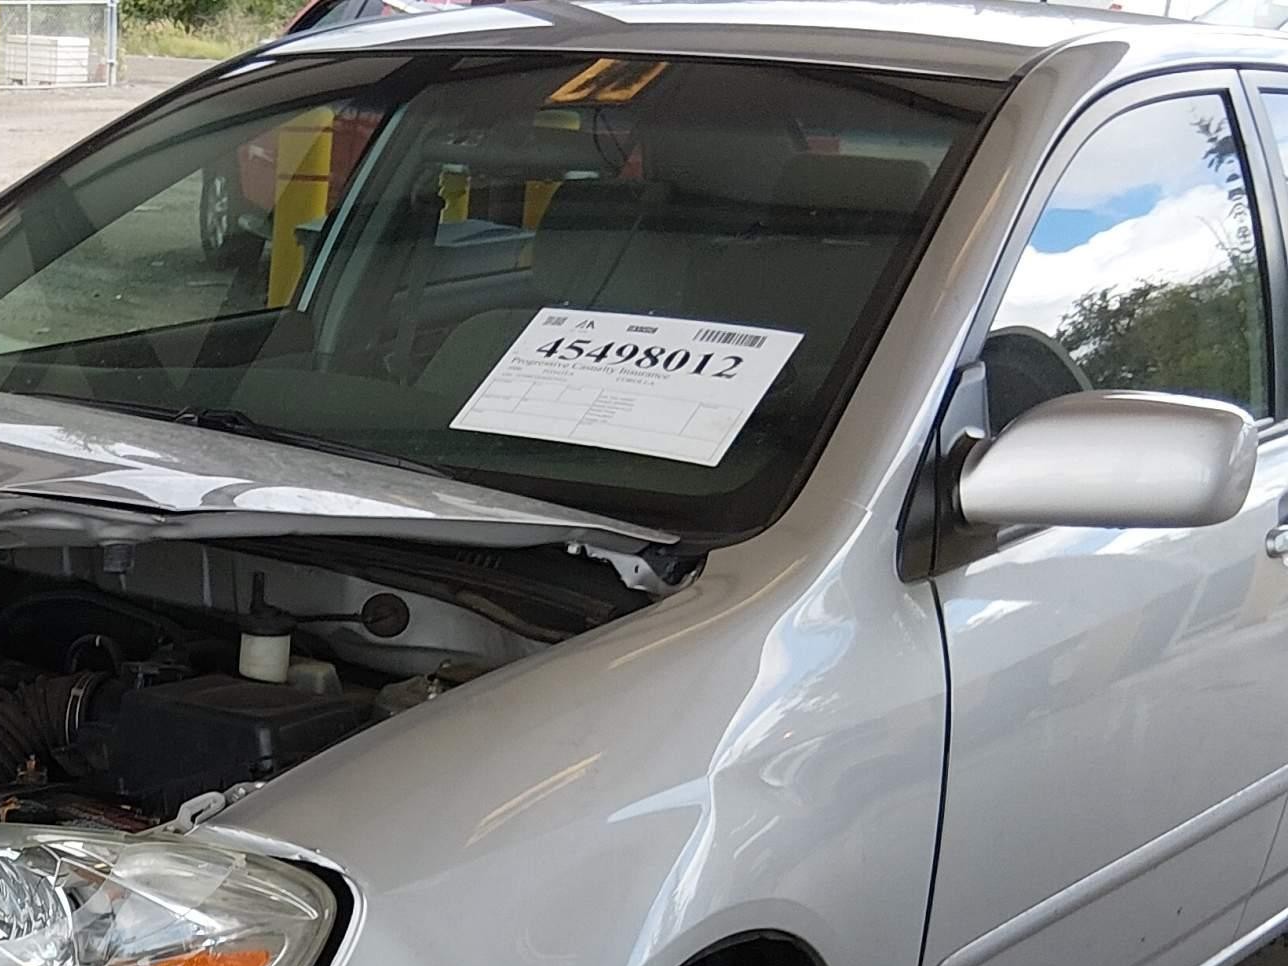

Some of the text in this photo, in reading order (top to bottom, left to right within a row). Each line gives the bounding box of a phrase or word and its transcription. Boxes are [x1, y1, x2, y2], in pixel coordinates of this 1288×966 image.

[511, 357, 570, 369] Progressive
[572, 361, 615, 374] Casualty
[619, 367, 671, 380] Insurance
[536, 337, 744, 379] 45498012
